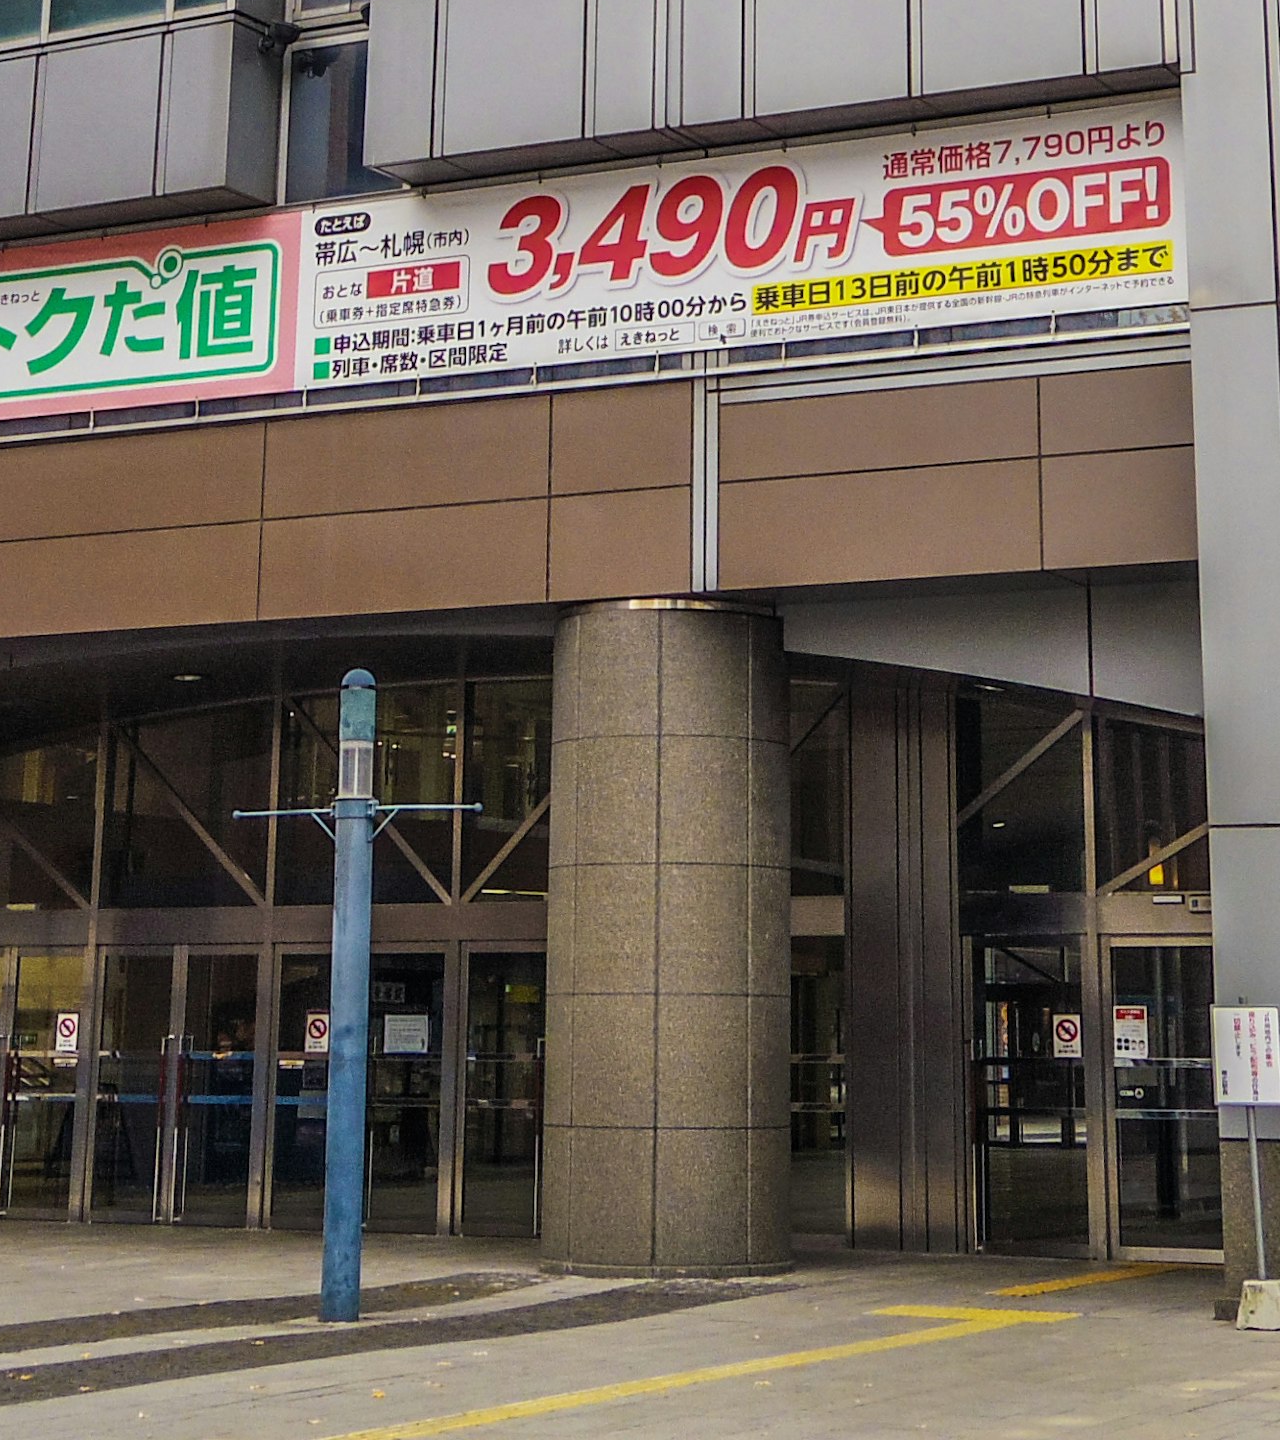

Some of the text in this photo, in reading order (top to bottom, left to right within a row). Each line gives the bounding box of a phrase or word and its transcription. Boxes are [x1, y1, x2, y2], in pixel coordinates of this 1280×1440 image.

[882, 120, 1166, 180] 通常価格7,790円より
[320, 215, 366, 233] たとえば
[487, 165, 856, 295] 3,490円
[897, 165, 1160, 248] 55%OFF!
[322, 266, 435, 300] おとな 片道
[755, 244, 1169, 311] 乗車日13日前の午前1時50分まで
[558, 335, 609, 354] 詳しくは
[620, 327, 680, 347] えきねっと
